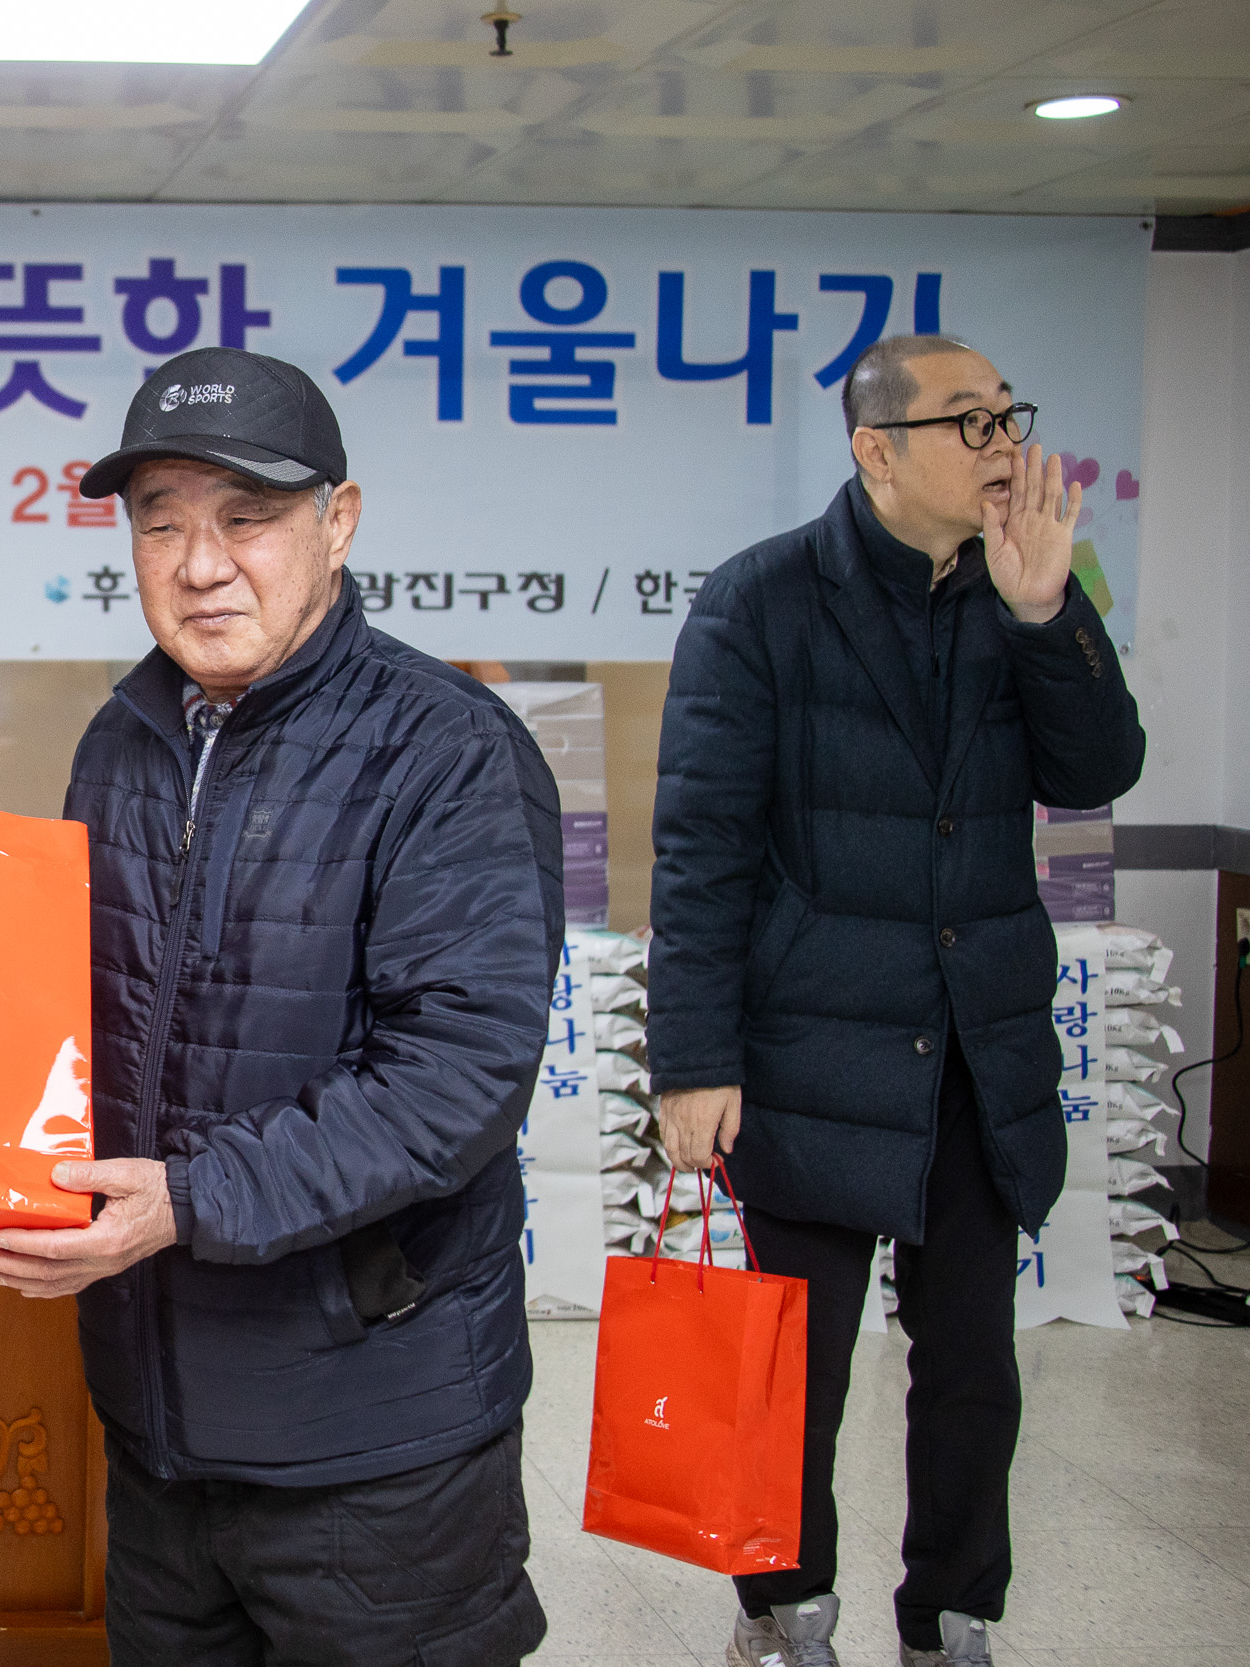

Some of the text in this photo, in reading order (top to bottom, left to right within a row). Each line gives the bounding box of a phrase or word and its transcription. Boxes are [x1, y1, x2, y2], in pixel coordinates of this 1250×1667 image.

[331, 260, 944, 426] 겨울나기
[188, 394, 232, 405] SPORTS
[190, 384, 235, 395] WORLD
[10, 460, 119, 528] 2월
[82, 564, 139, 613] 후
[352, 570, 565, 614] 광진구청
[1052, 957, 1099, 1123] 사랑나눔
